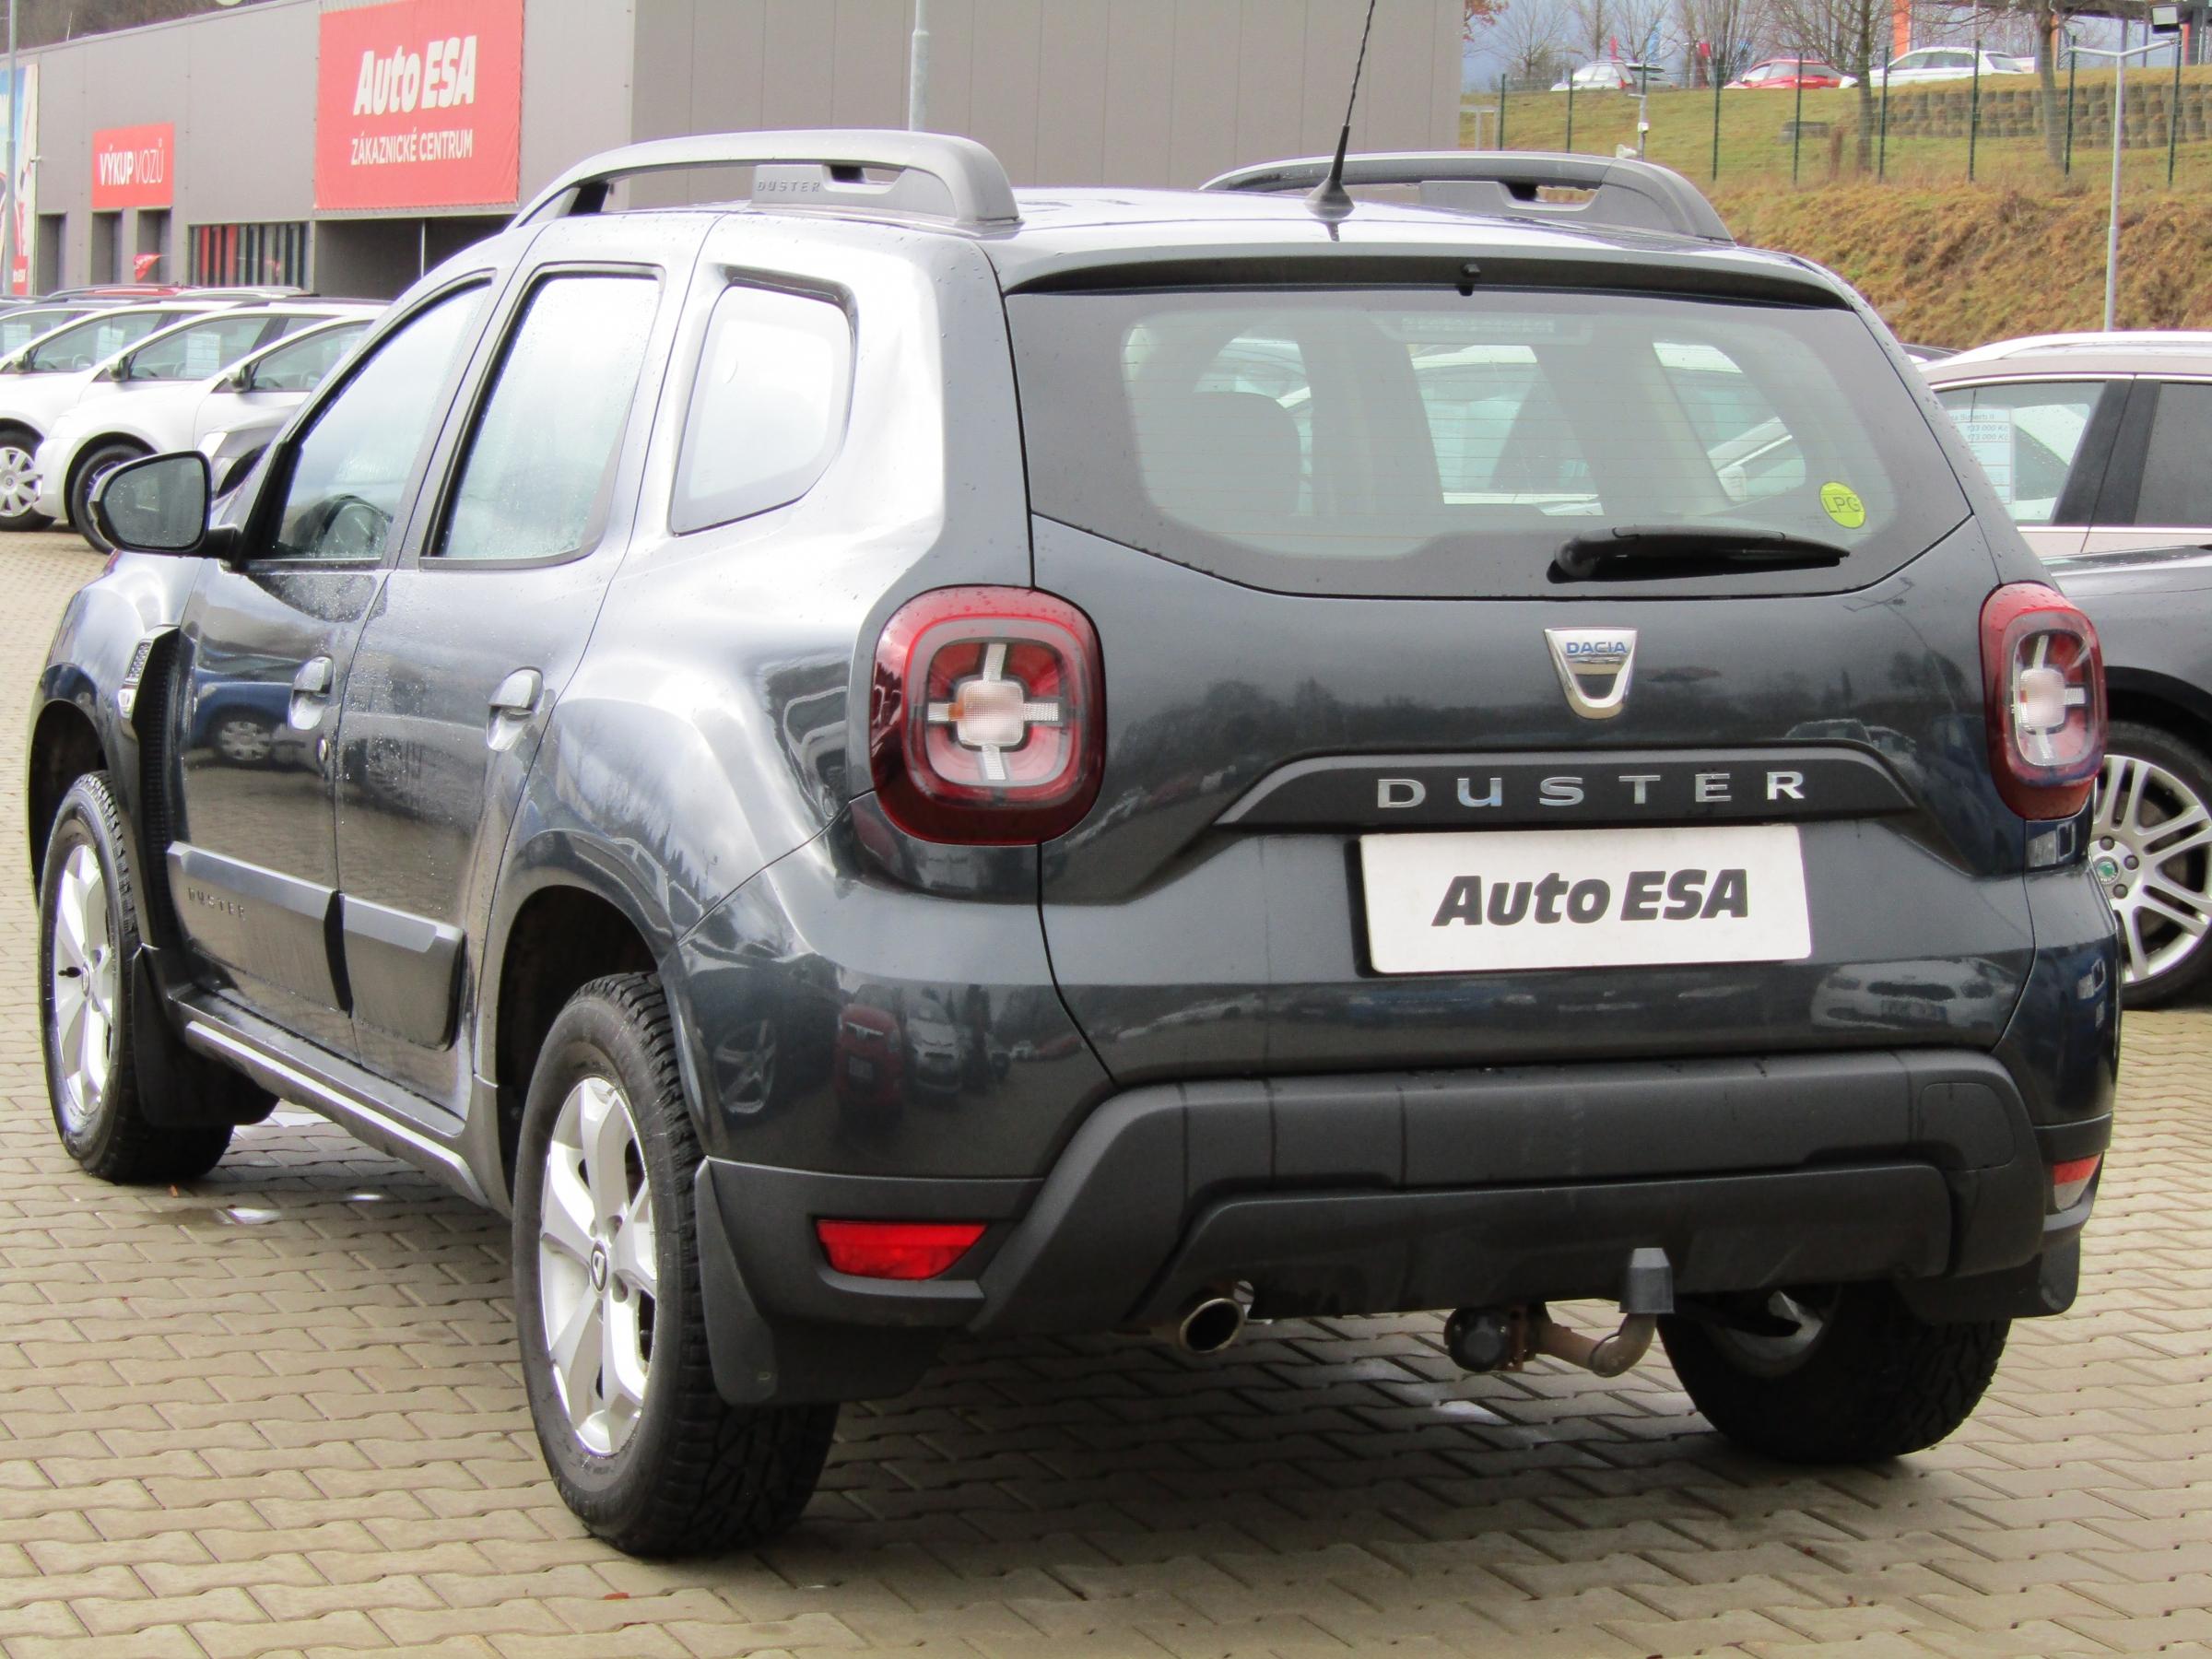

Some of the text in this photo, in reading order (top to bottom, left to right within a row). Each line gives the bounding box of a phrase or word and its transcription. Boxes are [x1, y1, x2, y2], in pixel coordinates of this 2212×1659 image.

[353, 35, 477, 116] Auto ESA
[100, 143, 134, 186] VÝKUP
[351, 126, 473, 166] ZÁKAZNICKÉ CENTRUM
[756, 181, 820, 193] DUSTER
[1824, 497, 1861, 512] LPG
[1566, 641, 1627, 654] DACIA
[1377, 771, 1806, 809] DUSTER
[1431, 869, 1748, 927] Auto ESA
